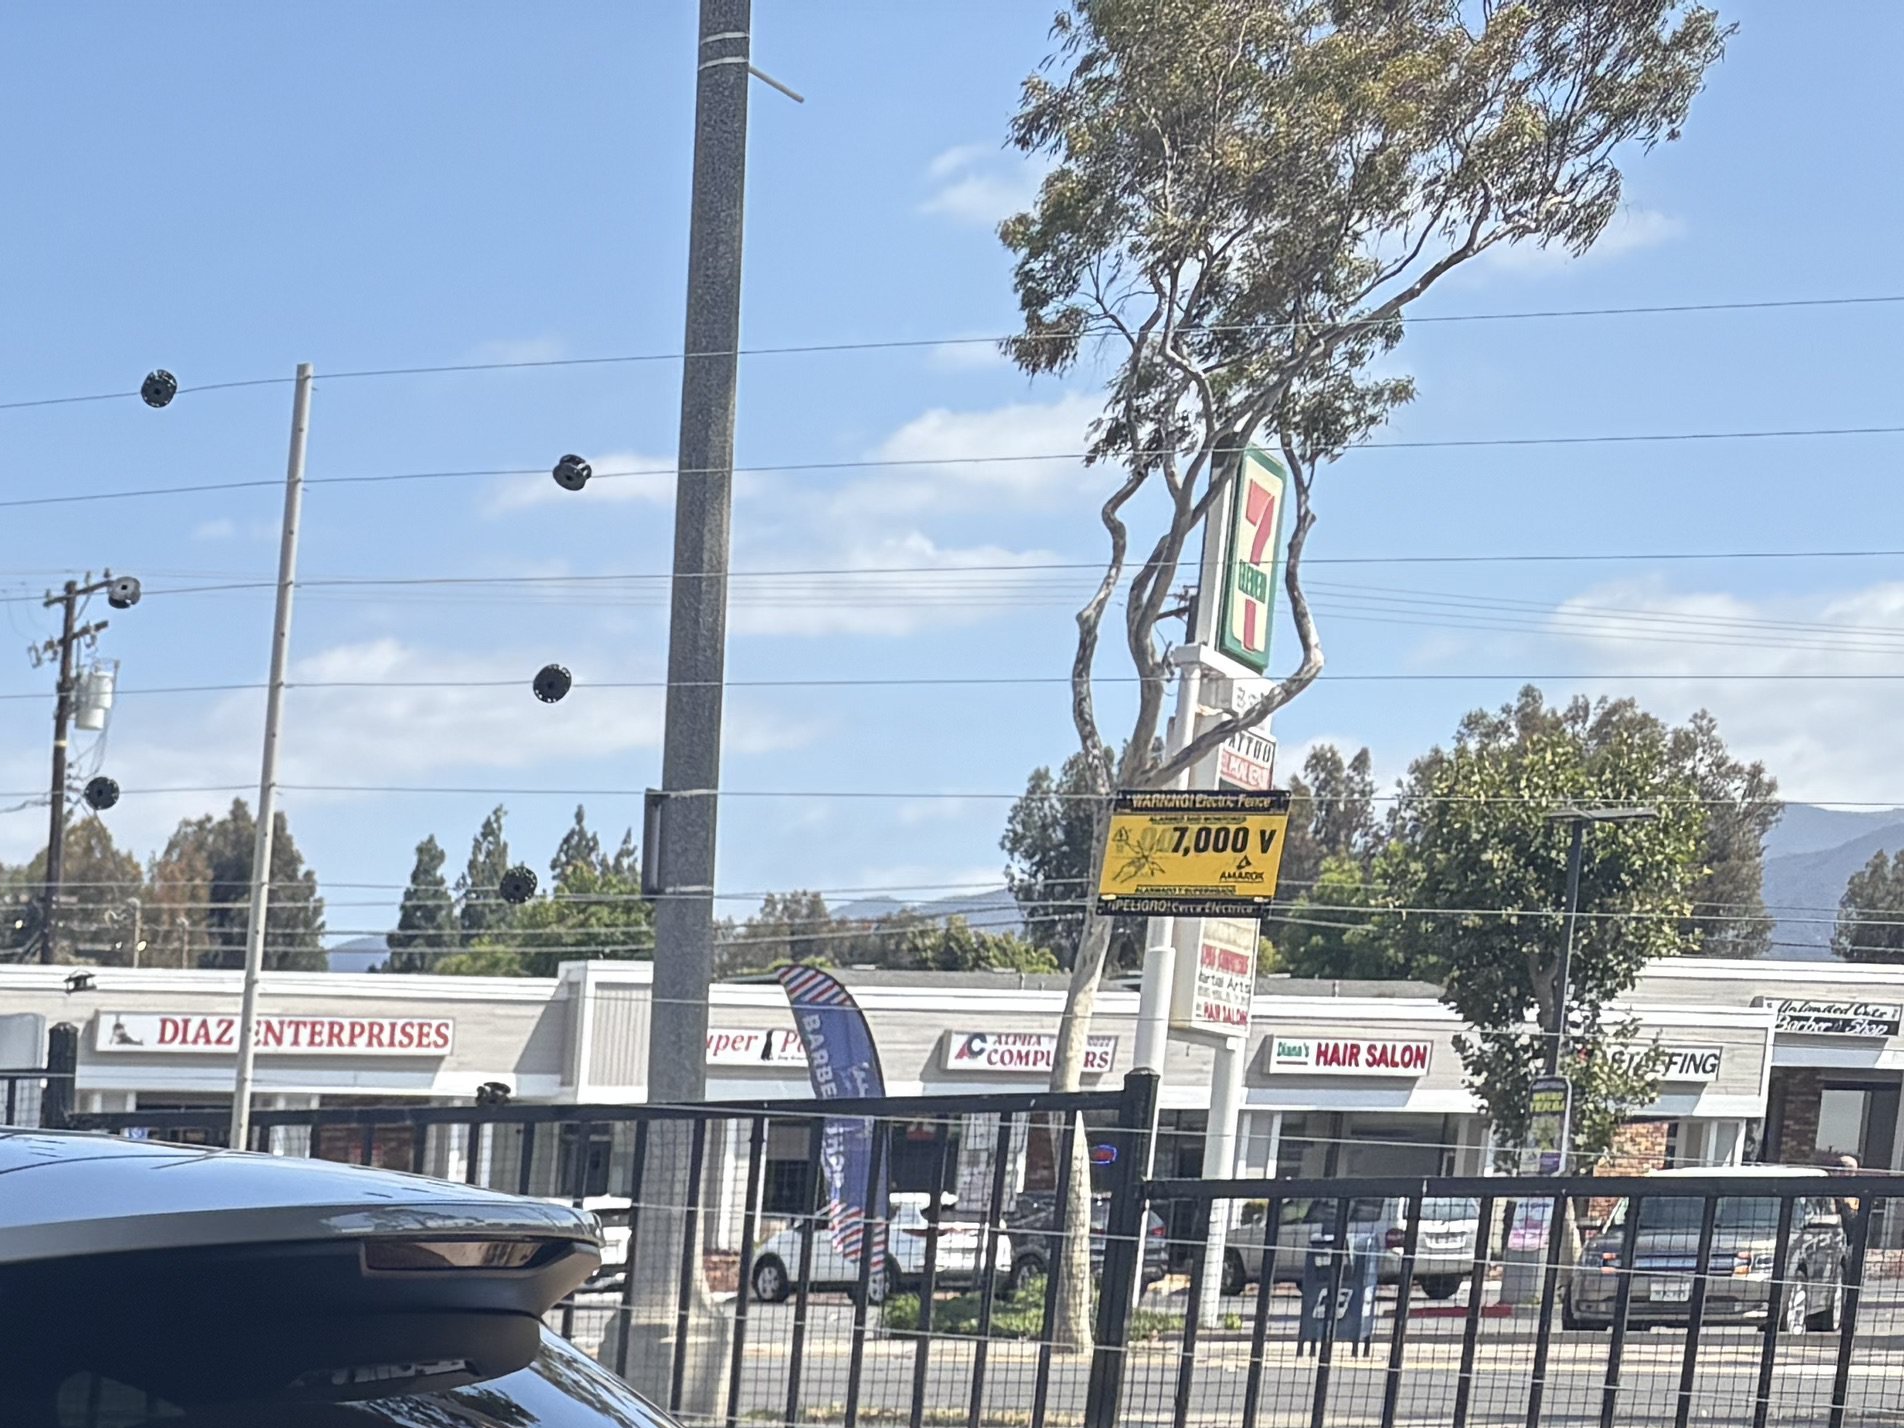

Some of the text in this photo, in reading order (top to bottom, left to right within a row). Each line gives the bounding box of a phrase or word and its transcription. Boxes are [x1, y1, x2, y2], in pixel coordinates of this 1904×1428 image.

[1237, 794, 1271, 808] Fence
[1171, 826, 1277, 857] 7,000 V
[157, 1017, 235, 1047] DIAZ
[1845, 1018, 1890, 1036] Shop
[802, 1013, 839, 1098] BARBE
[1315, 1041, 1361, 1068] HAIR
[1365, 1043, 1428, 1070] SALON
